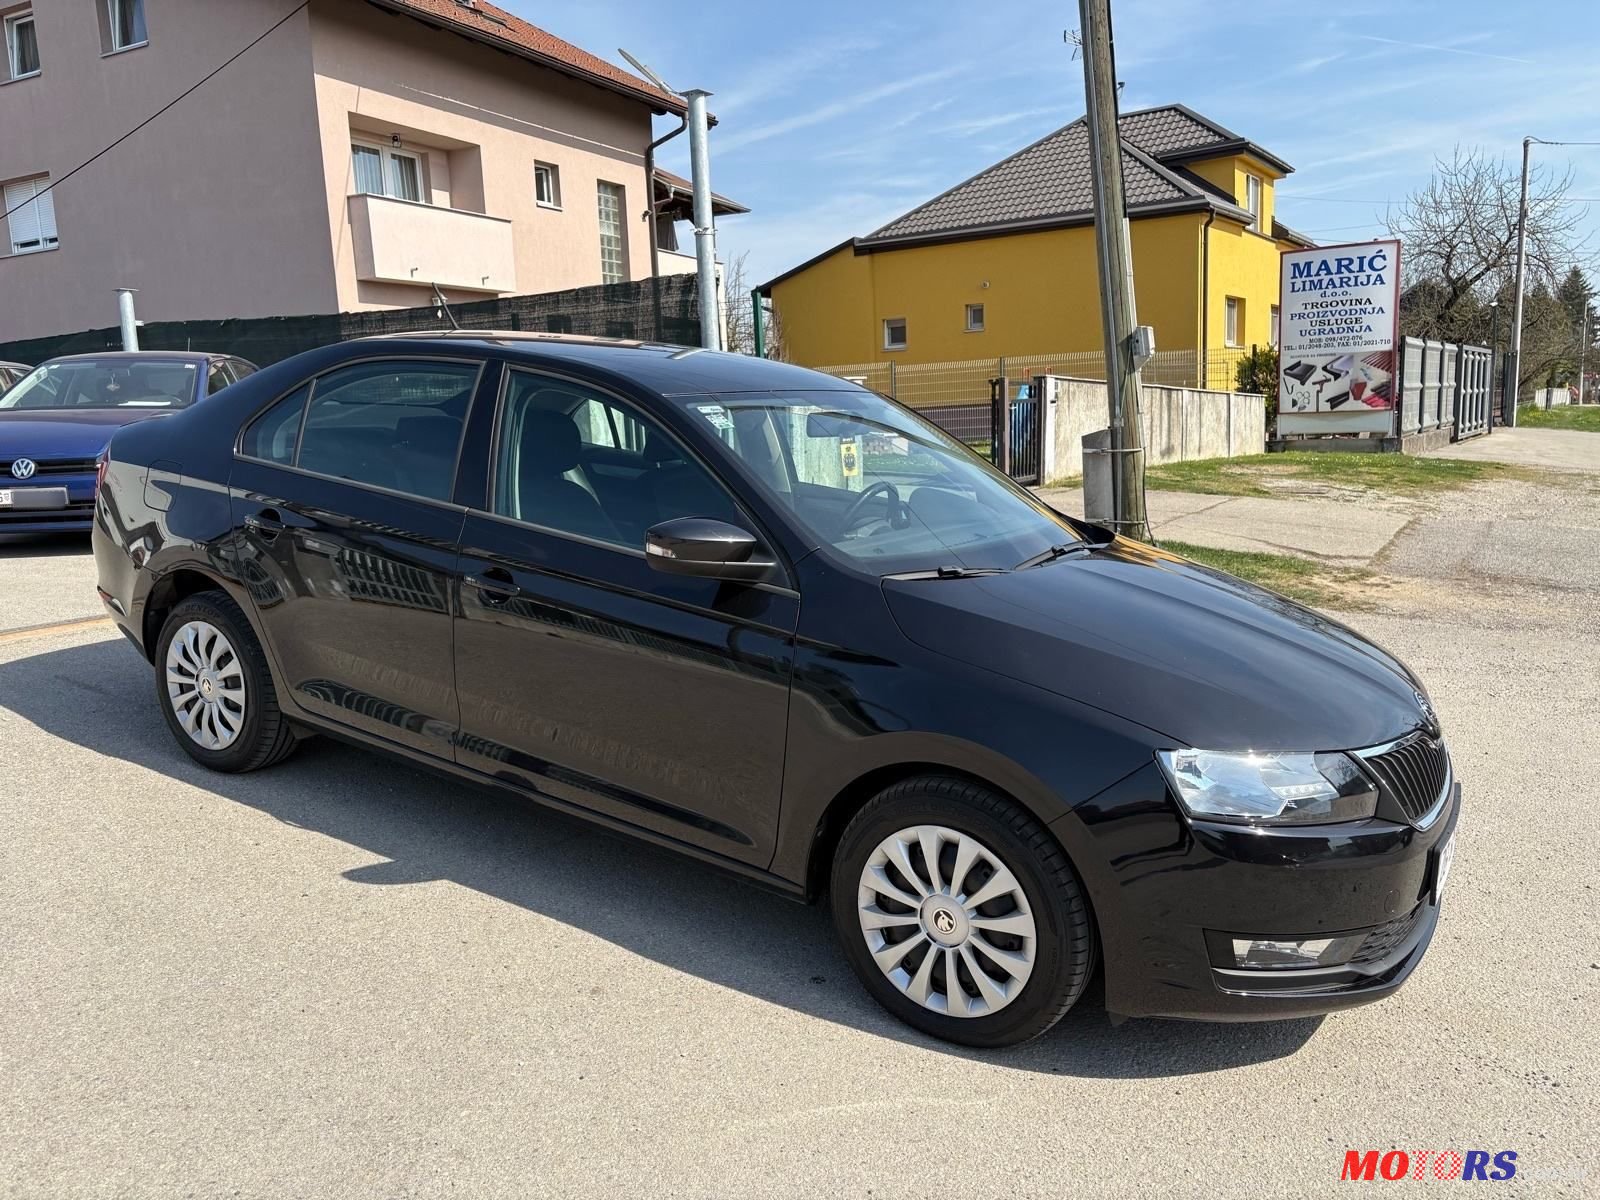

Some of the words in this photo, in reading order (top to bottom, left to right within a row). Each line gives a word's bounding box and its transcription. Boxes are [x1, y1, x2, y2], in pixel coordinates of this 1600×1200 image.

[1290, 249, 1387, 280] MARIĆ
[1290, 273, 1386, 293] LIMARIJA
[1320, 290, 1352, 298] d.o.o.
[1302, 298, 1373, 311] TRGOVINA
[1290, 306, 1386, 321] PROIZVODNJA
[1309, 317, 1363, 327] USLUGE
[1299, 325, 1373, 337] UGRADNJA
